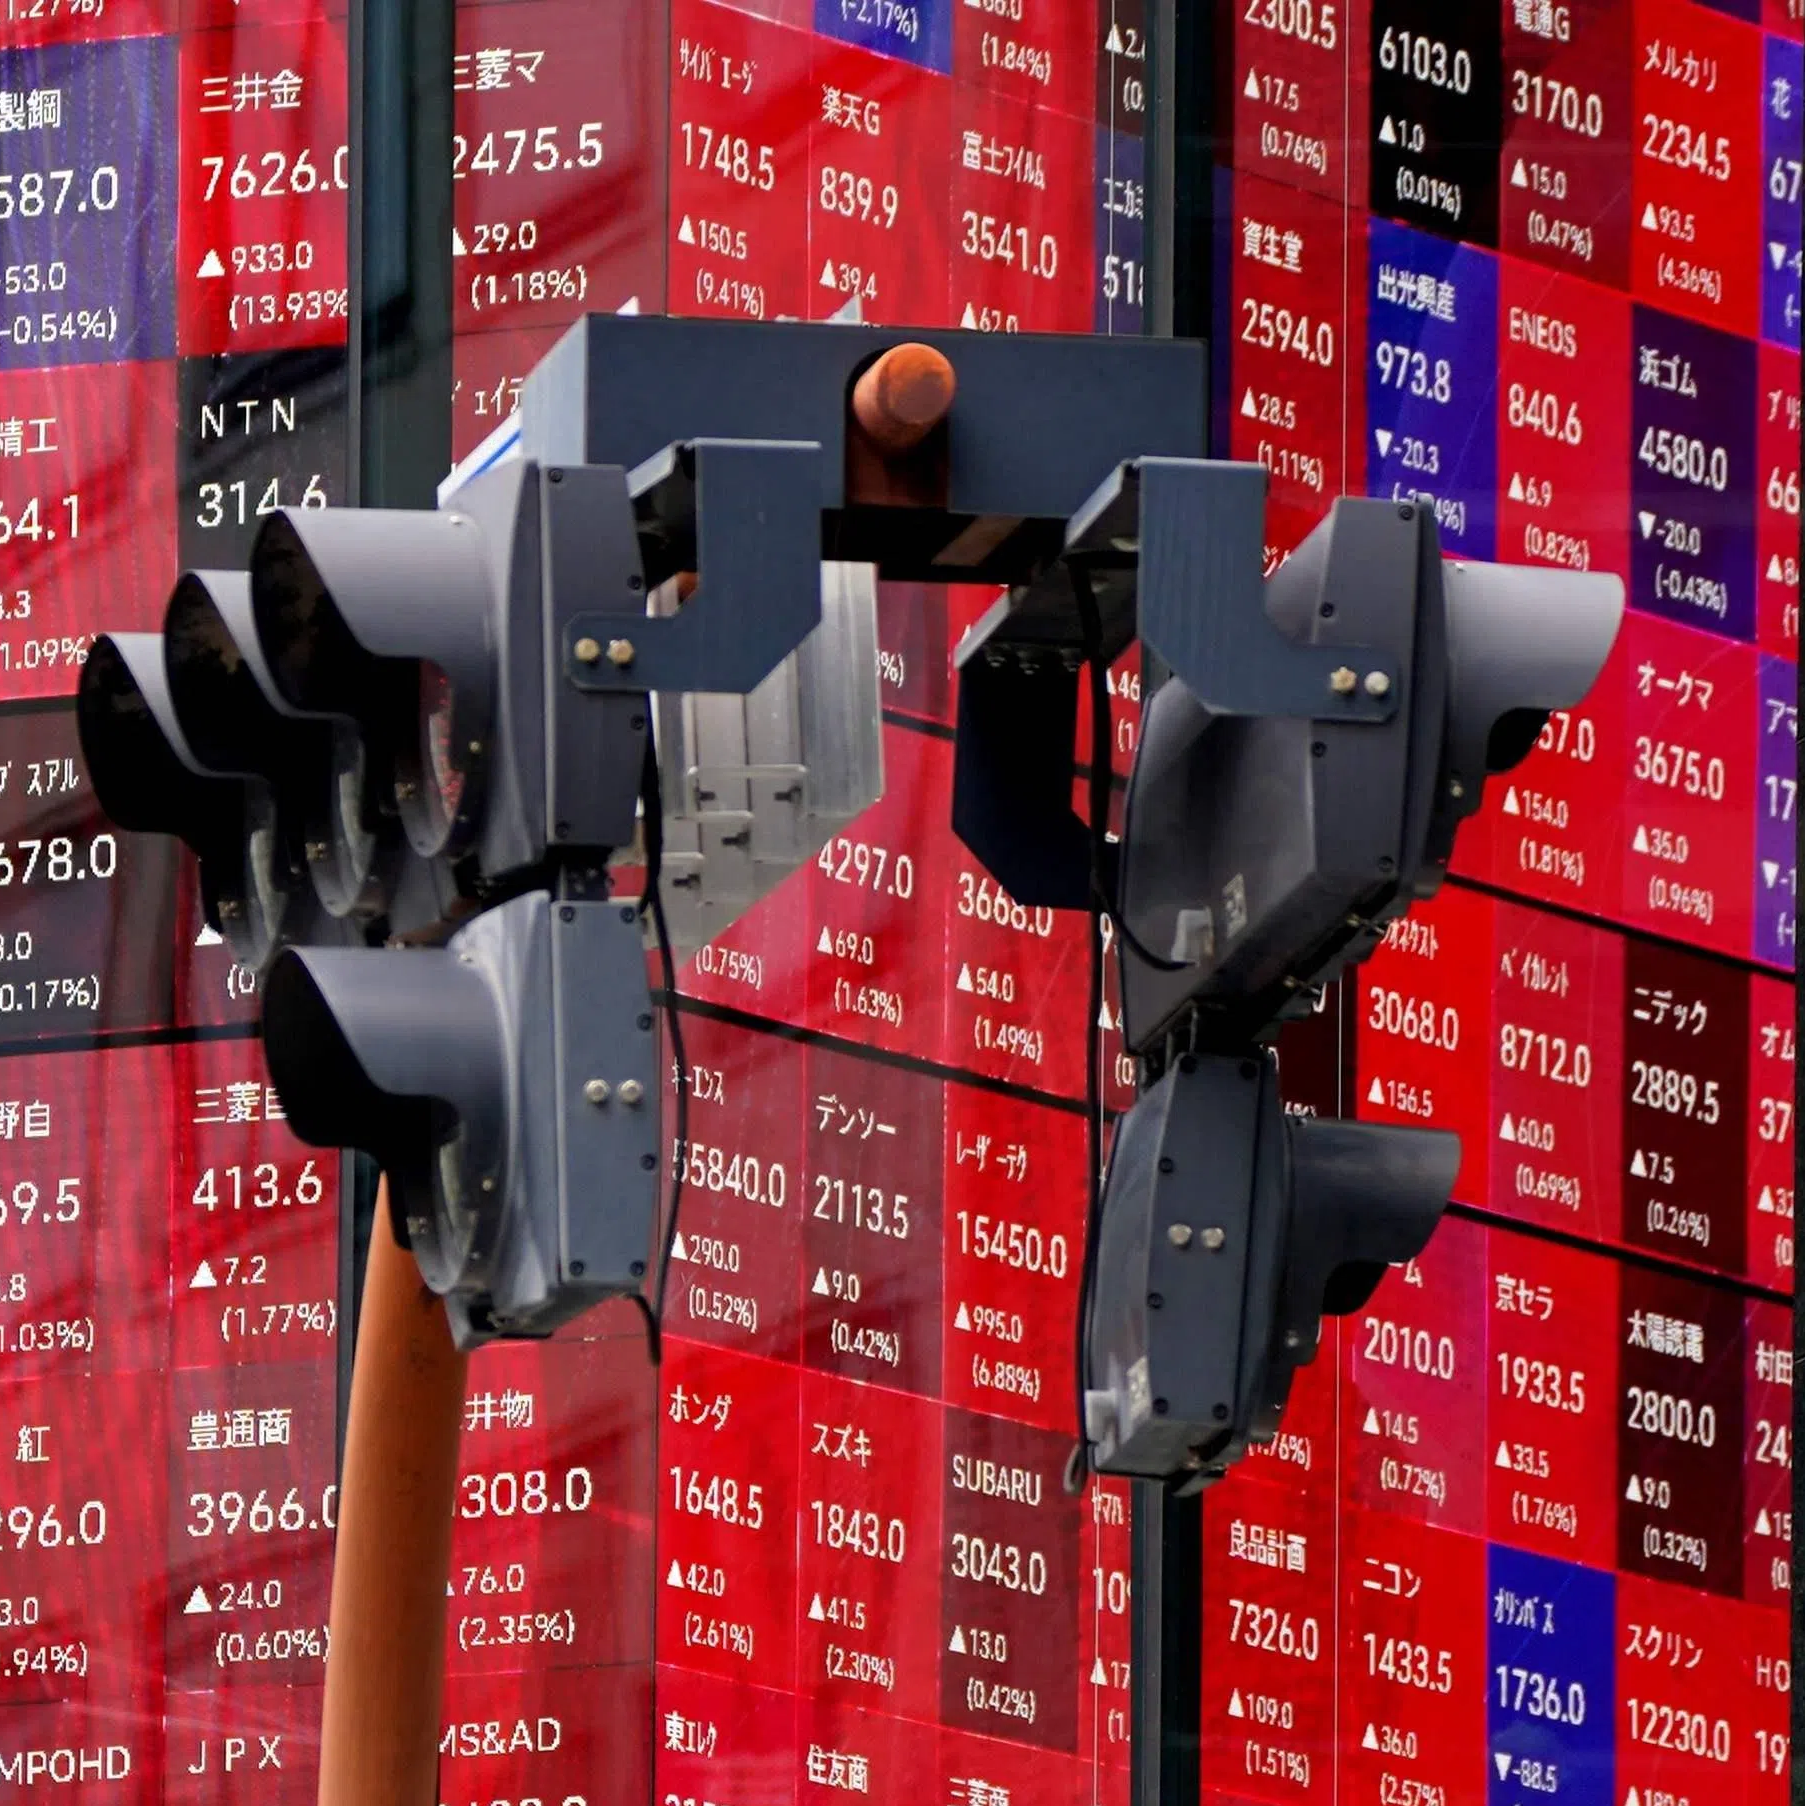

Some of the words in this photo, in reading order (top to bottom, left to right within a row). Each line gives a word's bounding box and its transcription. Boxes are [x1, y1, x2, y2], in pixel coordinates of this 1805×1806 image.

[1380, 27, 1470, 93] 6103.0
[1645, 41, 1715, 91] メルカリ
[201, 69, 302, 111] 三井金
[822, 87, 879, 135] 楽天G
[1513, 70, 1602, 137] 3170.0
[682, 122, 774, 190] 1748.5
[232, 241, 312, 274] 933.0
[699, 220, 746, 259] 150.5
[963, 211, 1057, 279] 3541.0
[1243, 218, 1302, 272] 資生堂
[840, 264, 876, 300] 39.4
[1242, 299, 1332, 365] 2594.0
[1510, 307, 1576, 357] ENEOS
[1377, 342, 1450, 402] 973.8
[1640, 346, 1696, 397] 浜ゴム
[1394, 438, 1438, 473] -20.3
[1639, 427, 1726, 490] 4580.0
[1638, 662, 1713, 709] オークマ
[835, 978, 902, 1027] (1.63%)
[1370, 987, 1458, 1050] 3068.0
[1634, 988, 1706, 1034] ニデック
[1501, 1024, 1590, 1086] 8712.0
[816, 1095, 895, 1139] デンソー
[1388, 1081, 1432, 1117] 156.5
[193, 1161, 321, 1210] 413.6
[957, 1212, 1067, 1278] 15450.0
[222, 1300, 336, 1341] (1.77%)
[1496, 1274, 1553, 1320] 京セラ
[187, 1408, 291, 1450] 豊通商
[669, 1385, 731, 1430] ホンダ
[1628, 1387, 1715, 1447] 2800.0
[812, 1424, 871, 1467] スズキ
[671, 1467, 762, 1529] 1648.5
[953, 1455, 1040, 1505] SUBARU
[952, 1534, 1045, 1595] 3043.0
[1229, 1520, 1306, 1572] 良品計画
[463, 1564, 524, 1594] 76.0
[686, 1564, 724, 1596] 42.0
[1363, 1559, 1420, 1597] ニコン
[827, 1597, 864, 1629] 41.5
[1230, 1600, 1318, 1660] 7326.0
[1626, 1625, 1702, 1668] スクリン
[967, 1677, 1035, 1723] (0.42%)
[1497, 1666, 1584, 1725] 1736.0
[1381, 1726, 1416, 1759] 36.0
[1628, 1699, 1729, 1761] 12230.0
[807, 1745, 867, 1793] 住友商
[1513, 1760, 1556, 1792] -88.5
